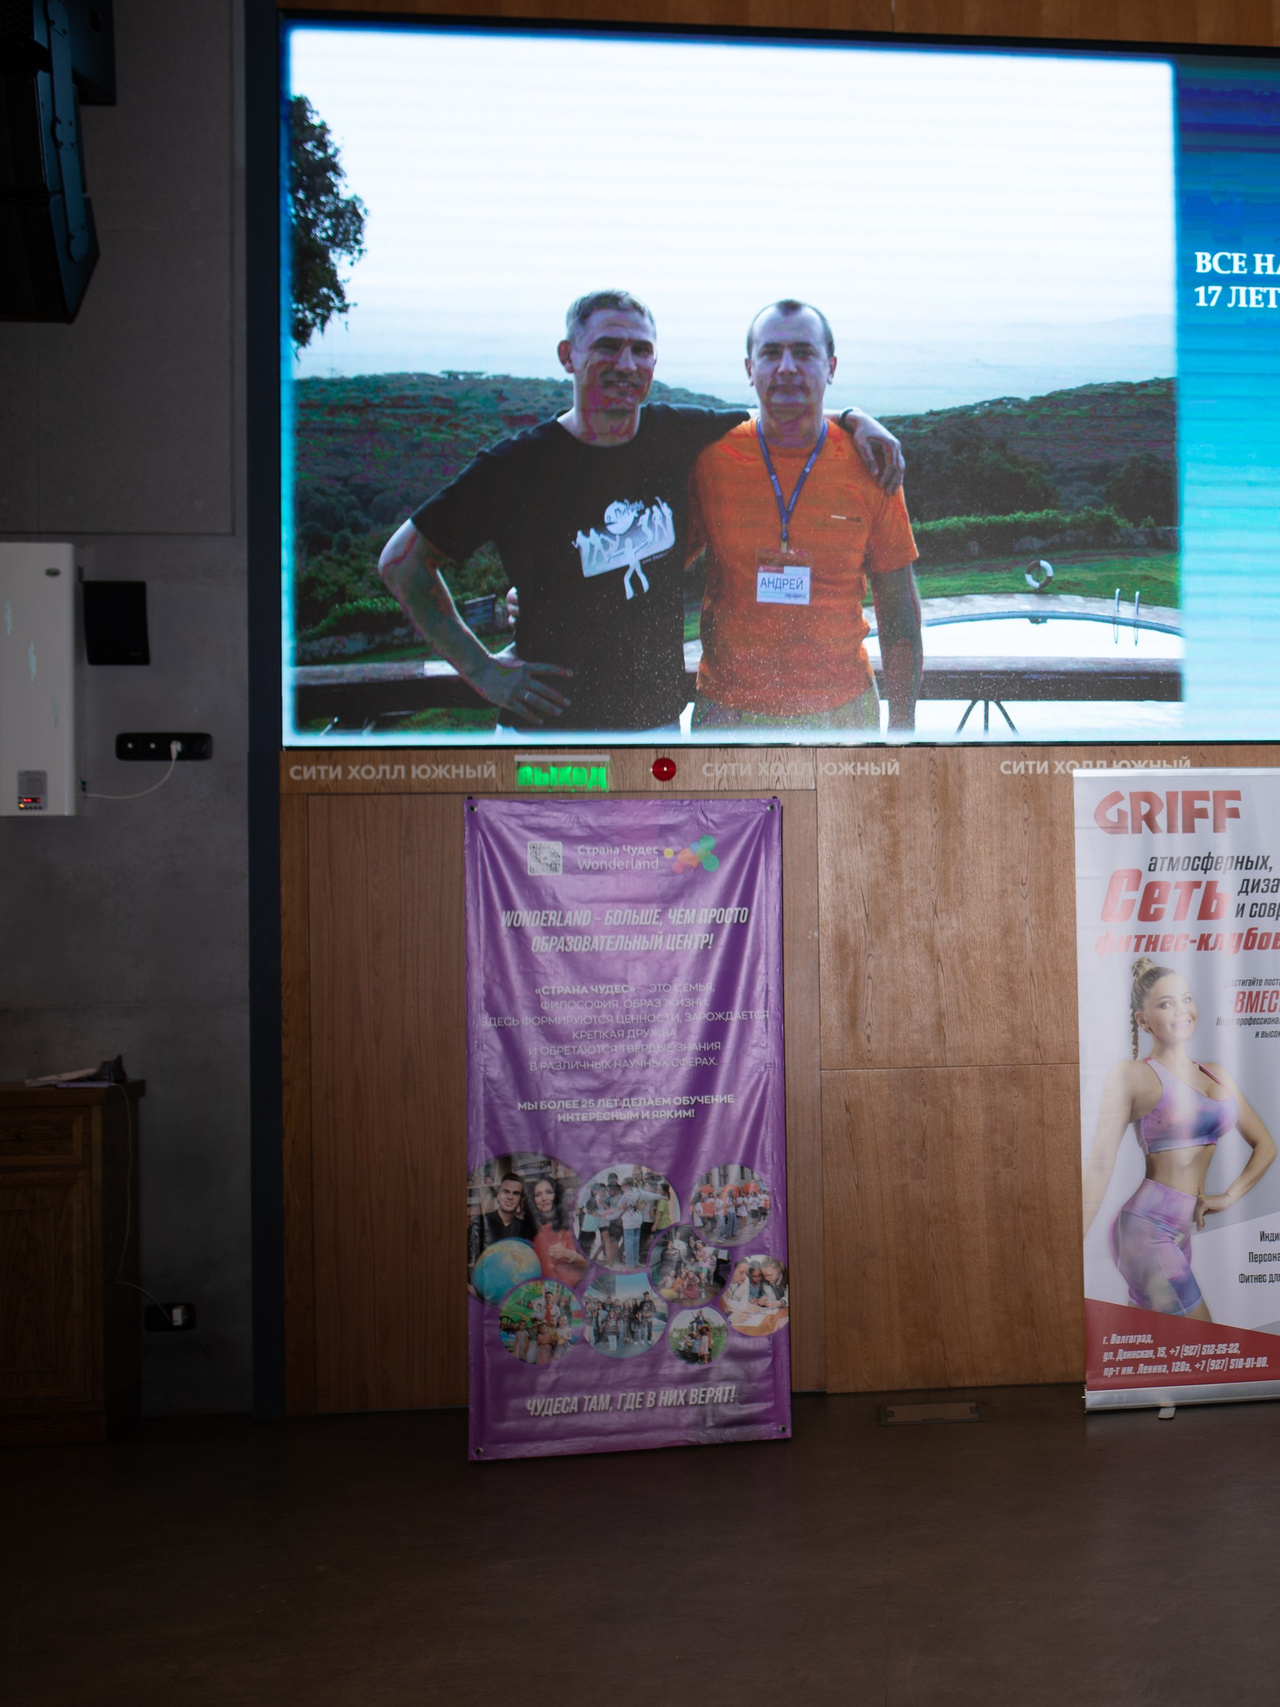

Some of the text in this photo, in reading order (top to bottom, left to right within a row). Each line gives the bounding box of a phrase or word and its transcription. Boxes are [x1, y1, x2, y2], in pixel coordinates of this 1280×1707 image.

[1194, 252, 1247, 274] ВСЕ
[1194, 286, 1222, 306] 17
[1228, 286, 1280, 308] ЛЕТ
[760, 577, 803, 591] АНДРЕЙ
[290, 761, 496, 780] СИТИ ХОЛЛ ЮЖНЫЙ
[702, 759, 900, 777] СИТИ ХОЛЛ ЮЖНЫЙ
[1000, 761, 1048, 774] СИТИ
[517, 766, 607, 789] ВЫХОД
[1094, 790, 1242, 834] GRIFF
[578, 844, 659, 857] Страна Чудес
[578, 857, 659, 871] Wonderland
[1148, 852, 1272, 874] атмосферных,
[1101, 869, 1230, 922] Сеть
[502, 909, 591, 927] WONDERLAND
[604, 909, 663, 927] БОЛЬШЕ,
[668, 908, 696, 925] ЧЕМ
[700, 907, 748, 924] ПРОСТО
[1236, 902, 1244, 918] и
[531, 931, 714, 952] ОБРАЗОВАТЕЛЬНЫЙ ЦЕНТР!
[535, 985, 589, 996] «СТРАНА
[591, 984, 635, 995] ЧУДЕС»
[649, 983, 672, 993] ЭТО
[1225, 977, 1263, 988] стигайте
[624, 999, 662, 1009] ОБРАЗ
[481, 1010, 769, 1027] ЗДЕСЬ ФОРМИРУЮТСЯ ЦЕННОСТИ, ЗАРОЖДАЕТСЯ
[573, 1028, 677, 1040] КРЕПКАЯ ДРУЖБА
[540, 1044, 617, 1056] ОБРЕТАЮТСЯ
[677, 1042, 721, 1052] ЗНАНИЯ
[530, 1060, 537, 1071] В
[540, 1059, 611, 1070] РАЗЛИЧНЫХ
[615, 1057, 668, 1068] НАУЧНЫХ
[518, 1094, 734, 1111] МЫ БОЛЕЕ 25 ЛЕТ ДЕЛАЕМ ОБУЧЕНИЕ
[558, 1108, 695, 1123] ИНТЕРЕСНЫМ И ЯРКИМ!
[1239, 1273, 1266, 1284] Фитнес
[526, 1386, 736, 1417] ЧУДЕСА ТАМ, ГДЕ В НИХ ВЕРЯТ!
